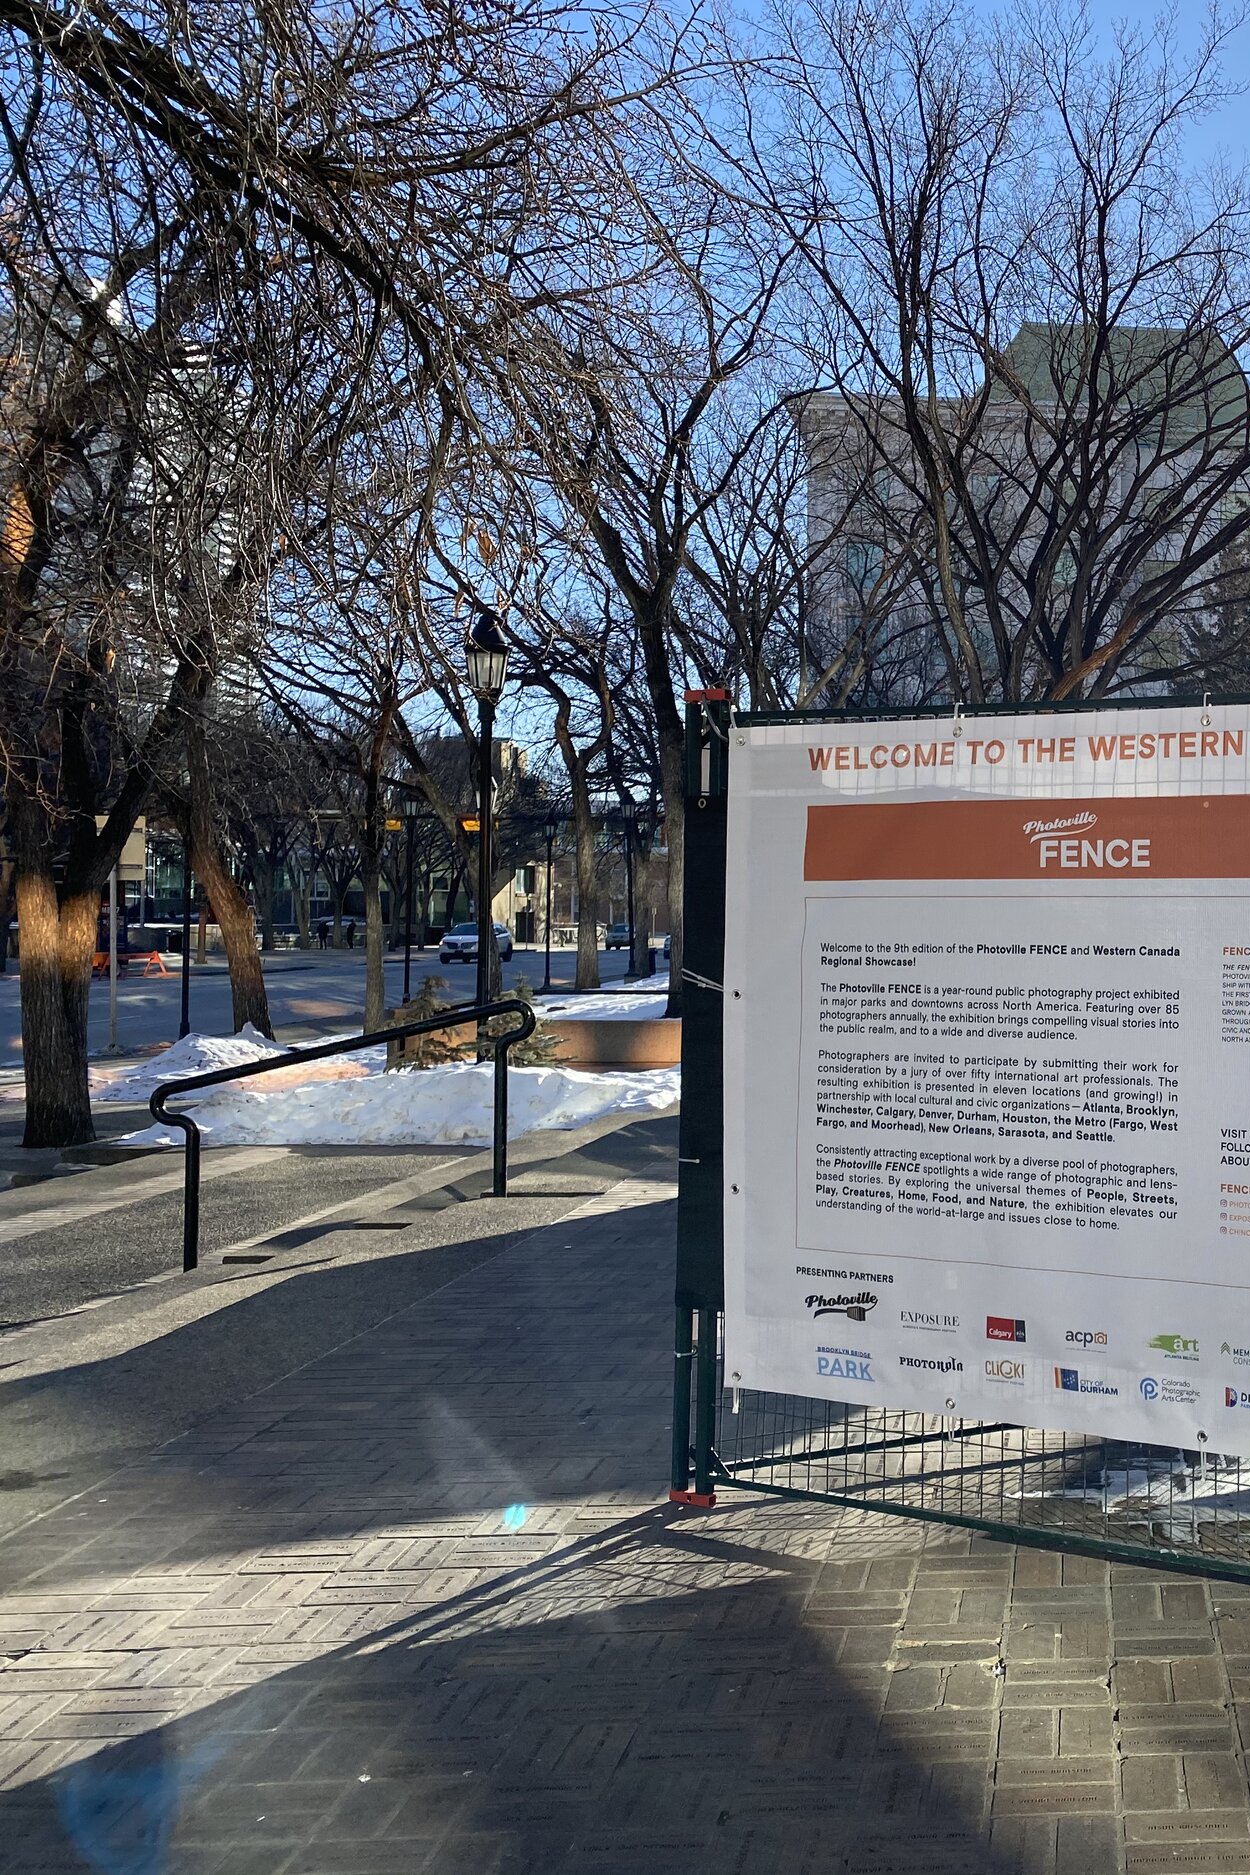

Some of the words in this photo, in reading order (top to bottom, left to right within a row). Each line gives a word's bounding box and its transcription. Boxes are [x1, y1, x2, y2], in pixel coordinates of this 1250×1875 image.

[808, 742, 955, 771] WELCOME
[967, 740, 1005, 764] TO
[1018, 737, 1075, 763] THE
[1088, 730, 1243, 761] WESTERN
[1023, 811, 1098, 836] Photoville
[1040, 839, 1150, 867] FENCE
[821, 943, 862, 952] Welcome
[865, 944, 874, 952] to
[877, 944, 891, 952] the
[894, 943, 909, 952] 9th
[912, 944, 943, 953] edition
[947, 944, 956, 953] of
[959, 944, 973, 953] the
[977, 944, 1026, 954] Photoville
[1030, 945, 1067, 954] FENCE
[1071, 946, 1089, 955] and
[1093, 946, 1135, 955] Western
[1139, 946, 1180, 956] Canada
[821, 956, 861, 967] Regional
[865, 957, 915, 966] Showcase!
[1221, 1129, 1247, 1138] VISIT
[796, 1266, 847, 1278] PRESENTING
[850, 1272, 893, 1283] PARTNERS
[805, 1292, 878, 1308] Photoville
[900, 1311, 960, 1327] EXPOSURE
[989, 1328, 1011, 1338] Calgary
[1066, 1331, 1093, 1347] acp
[817, 1347, 850, 1355] BROOKLYN
[1173, 1337, 1199, 1352] art
[817, 1357, 871, 1379] PARK
[1080, 1386, 1118, 1395] DURHAM
[1162, 1379, 1190, 1387] Colorado
[1162, 1388, 1200, 1396] Photographic
